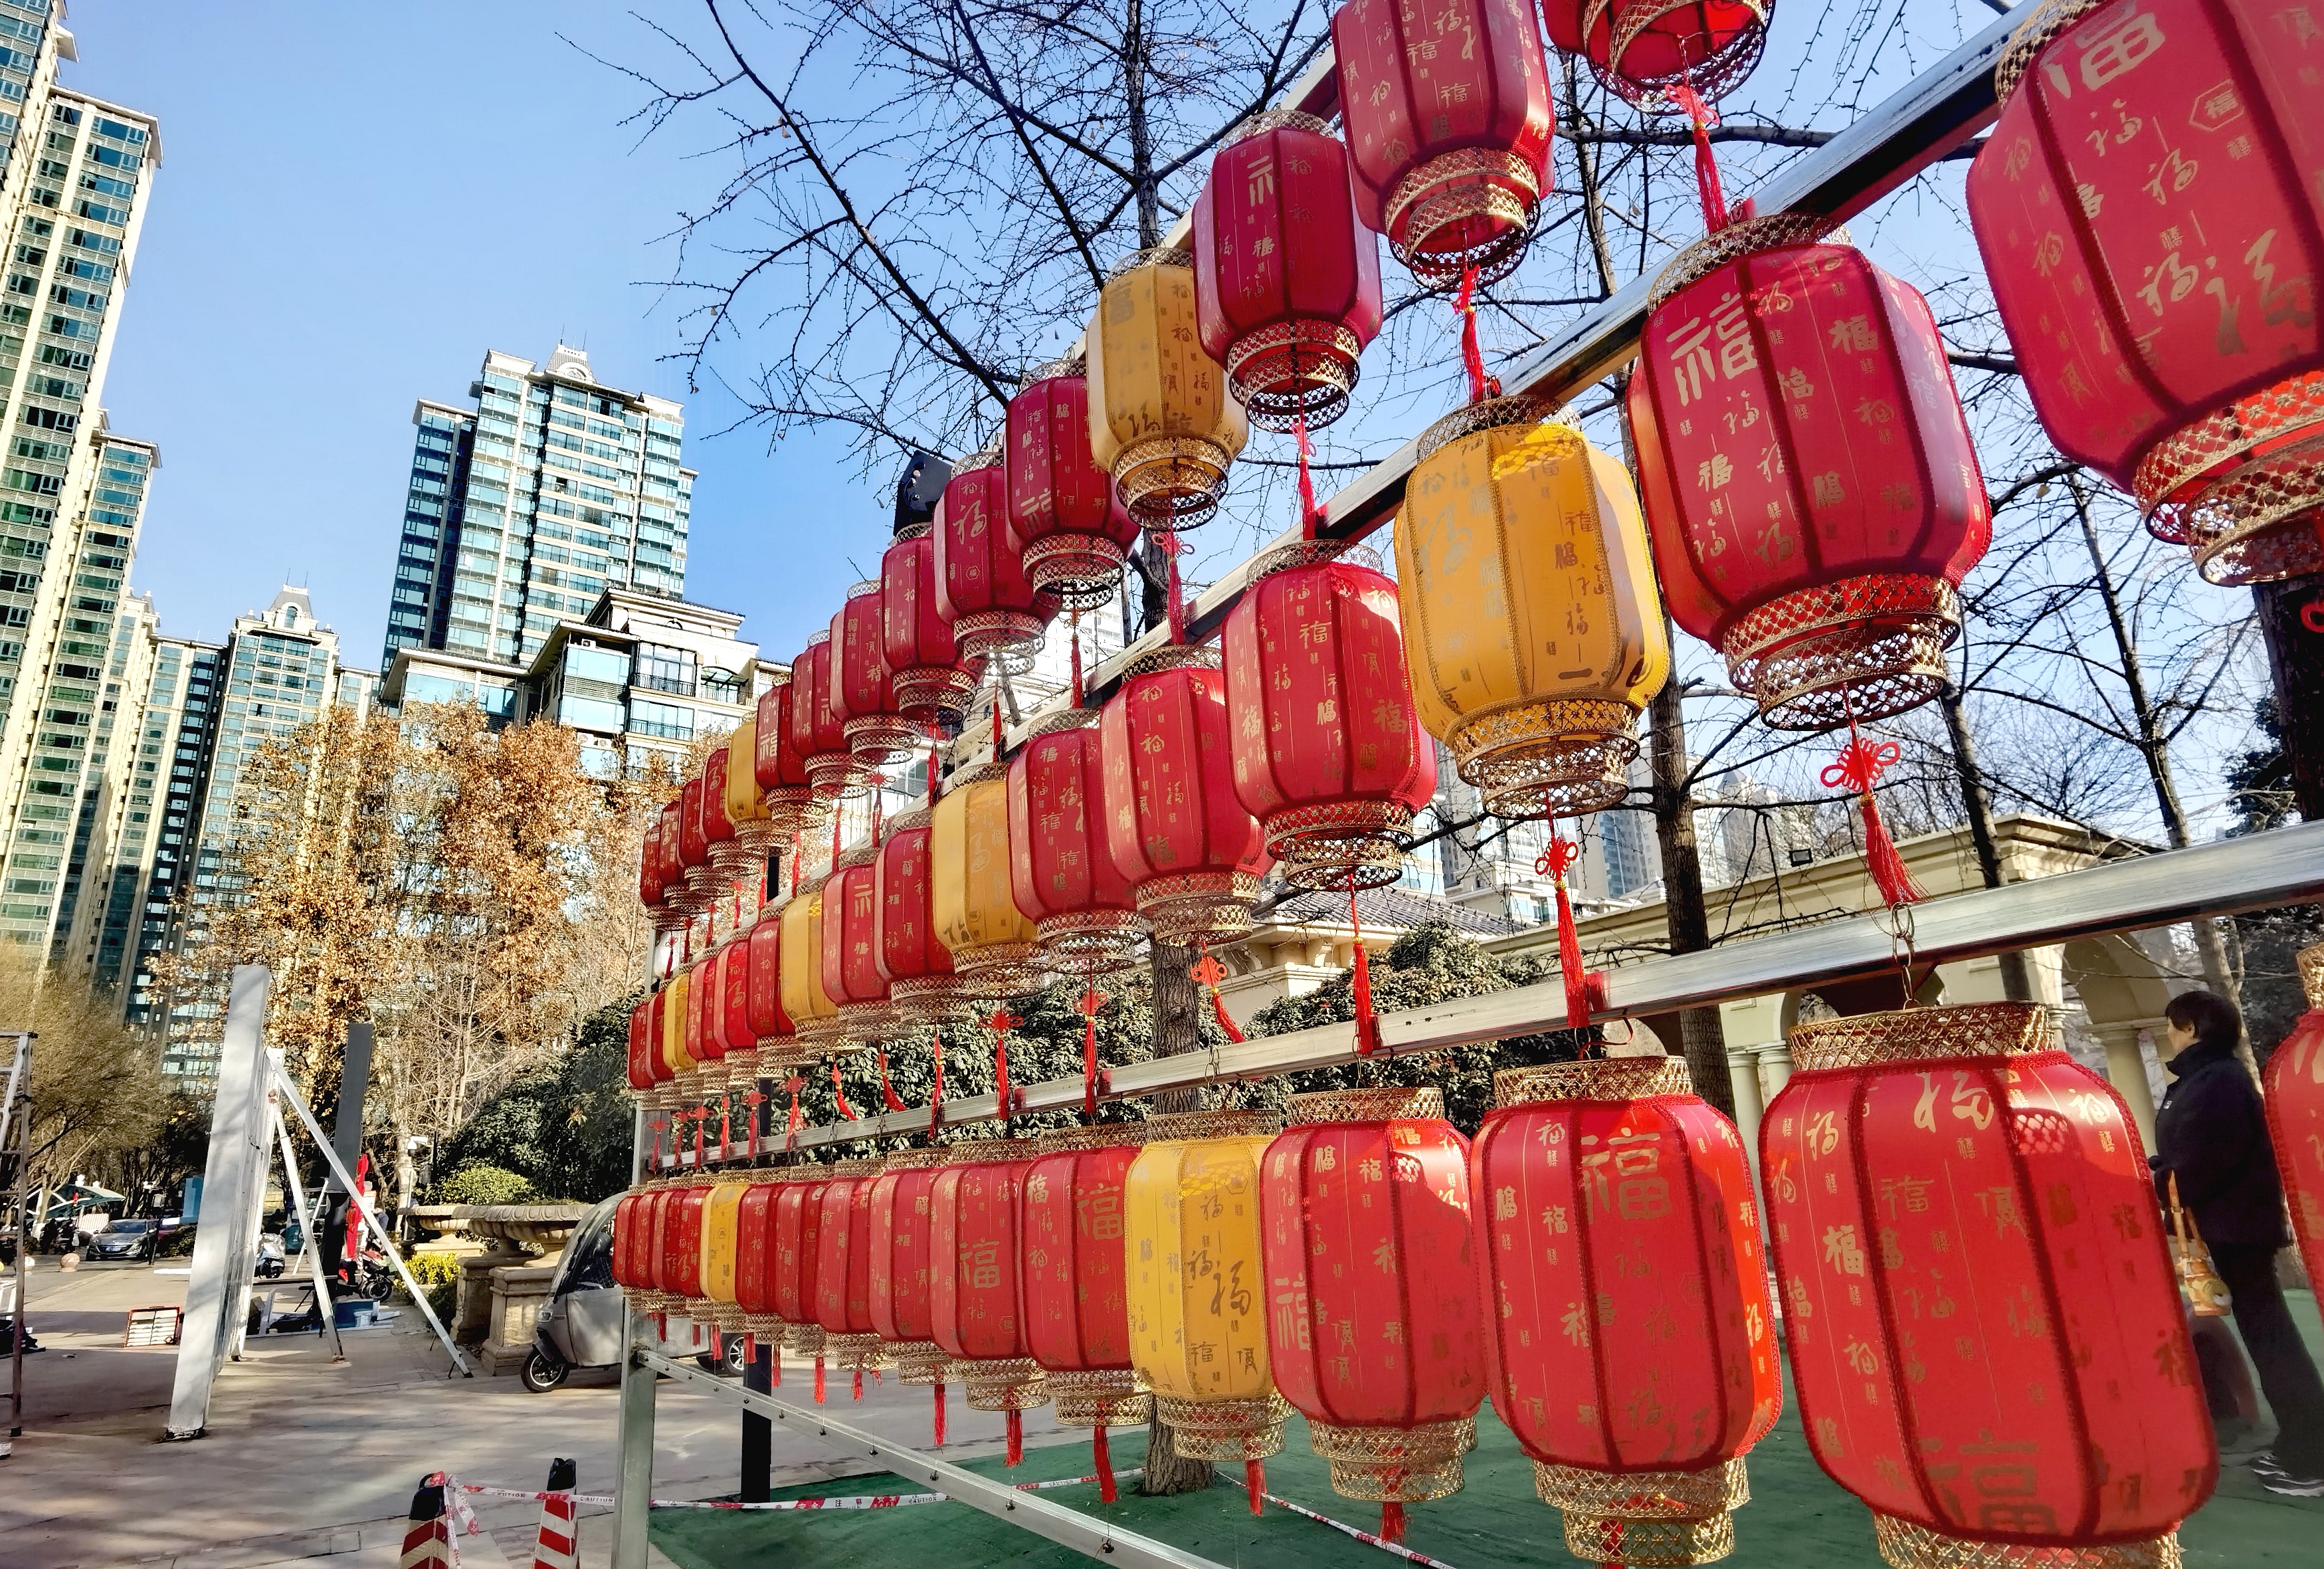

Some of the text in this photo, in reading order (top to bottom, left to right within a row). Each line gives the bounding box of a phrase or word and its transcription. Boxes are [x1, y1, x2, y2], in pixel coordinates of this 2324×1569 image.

[1433, 9, 1462, 35] 福
[1406, 39, 1442, 66] 福
[1440, 82, 1472, 108] 福
[2086, 99, 2142, 157] 福
[2143, 148, 2198, 205] 福
[1252, 237, 1275, 257] 福
[1760, 281, 1793, 315] 福
[2136, 252, 2199, 316] 福
[1666, 292, 1758, 407] 福
[1829, 316, 1878, 354] 福
[1723, 389, 1760, 435] 福
[1698, 453, 1734, 492] 福
[952, 500, 987, 546] 福
[1286, 579, 1310, 602] 福
[1298, 620, 1332, 649] 福
[1567, 602, 1589, 635] 福
[1275, 663, 1292, 691] 福
[1317, 699, 1335, 725] 福
[1373, 699, 1408, 735] 福
[759, 726, 778, 758] 福
[1040, 747, 1058, 762] 福
[1139, 733, 1165, 755] 福
[1060, 787, 1078, 809] 福
[1040, 812, 1063, 833] 福
[1060, 850, 1080, 869] 福
[1913, 1071, 1993, 1132] 福
[2069, 1089, 2109, 1125] 福
[1536, 1119, 1565, 1148] 福
[1806, 1110, 1838, 1161] 福
[1314, 1144, 1336, 1174] 福
[1359, 1157, 1383, 1184] 福
[1027, 1174, 1049, 1203] 福
[1582, 1128, 1672, 1225] 福
[1772, 1158, 1796, 1203] 福
[1077, 1183, 1123, 1240] 福
[1200, 1195, 1224, 1222] 福
[1496, 1186, 1517, 1221] 福
[1880, 1176, 1934, 1221] 福
[1542, 1205, 1569, 1236] 福
[959, 1237, 999, 1289] 福
[1187, 1250, 1213, 1281] 福
[1823, 1225, 1865, 1277] 福
[1210, 1260, 1252, 1318] 福
[1745, 1302, 1764, 1347] 福
[1191, 1341, 1217, 1368] 福
[1844, 1334, 1878, 1375] 福
